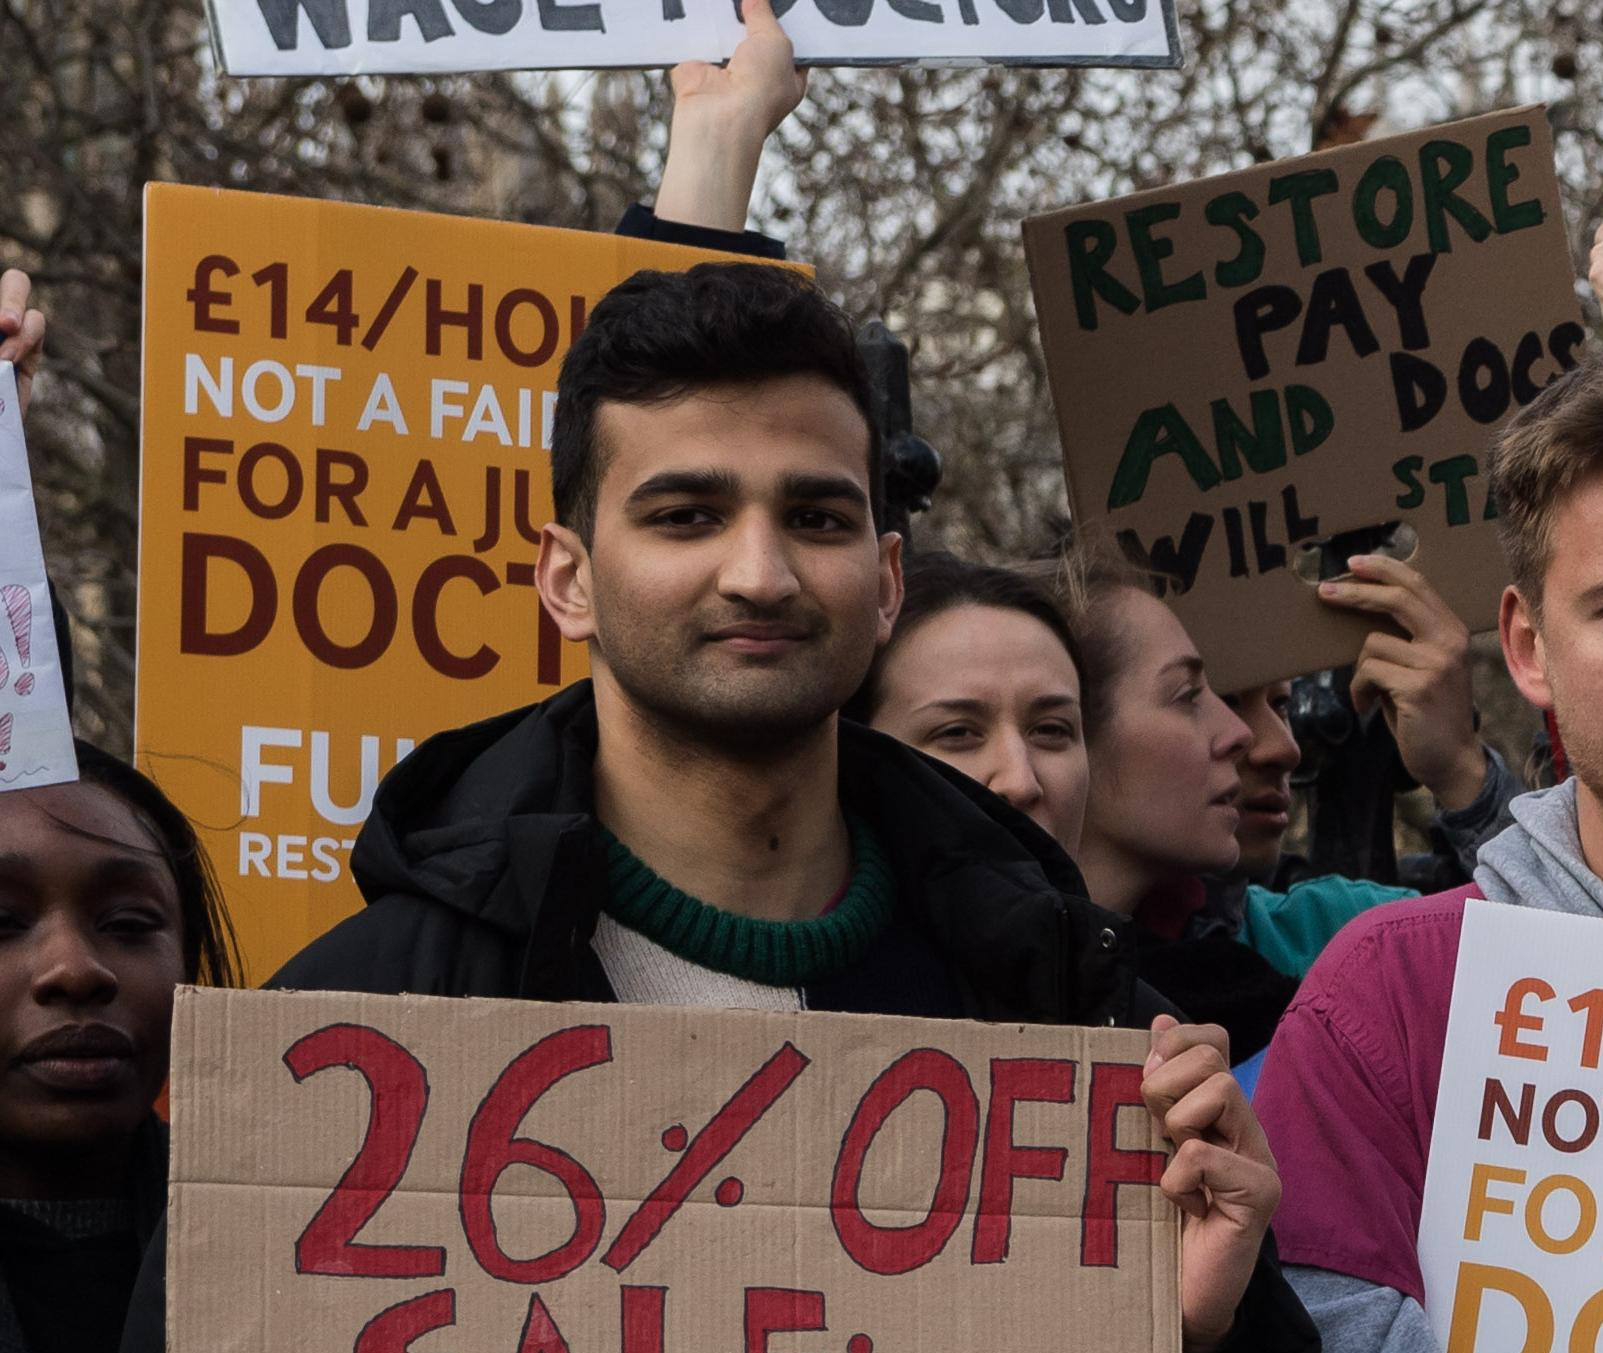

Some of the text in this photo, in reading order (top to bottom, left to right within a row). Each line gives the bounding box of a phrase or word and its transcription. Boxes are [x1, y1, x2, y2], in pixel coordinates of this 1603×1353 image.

[1065, 125, 1547, 331] RESTORE
[186, 254, 587, 368] £14/HO
[1233, 252, 1437, 380] PAY
[184, 353, 342, 427] NOT
[356, 373, 409, 435] A
[1107, 383, 1335, 513] AND
[183, 436, 369, 527] FOR
[392, 459, 458, 536] A
[1116, 484, 1319, 597] WILL
[180, 532, 562, 686] DOCT
[282, 1022, 1170, 1285] 26% OFF
